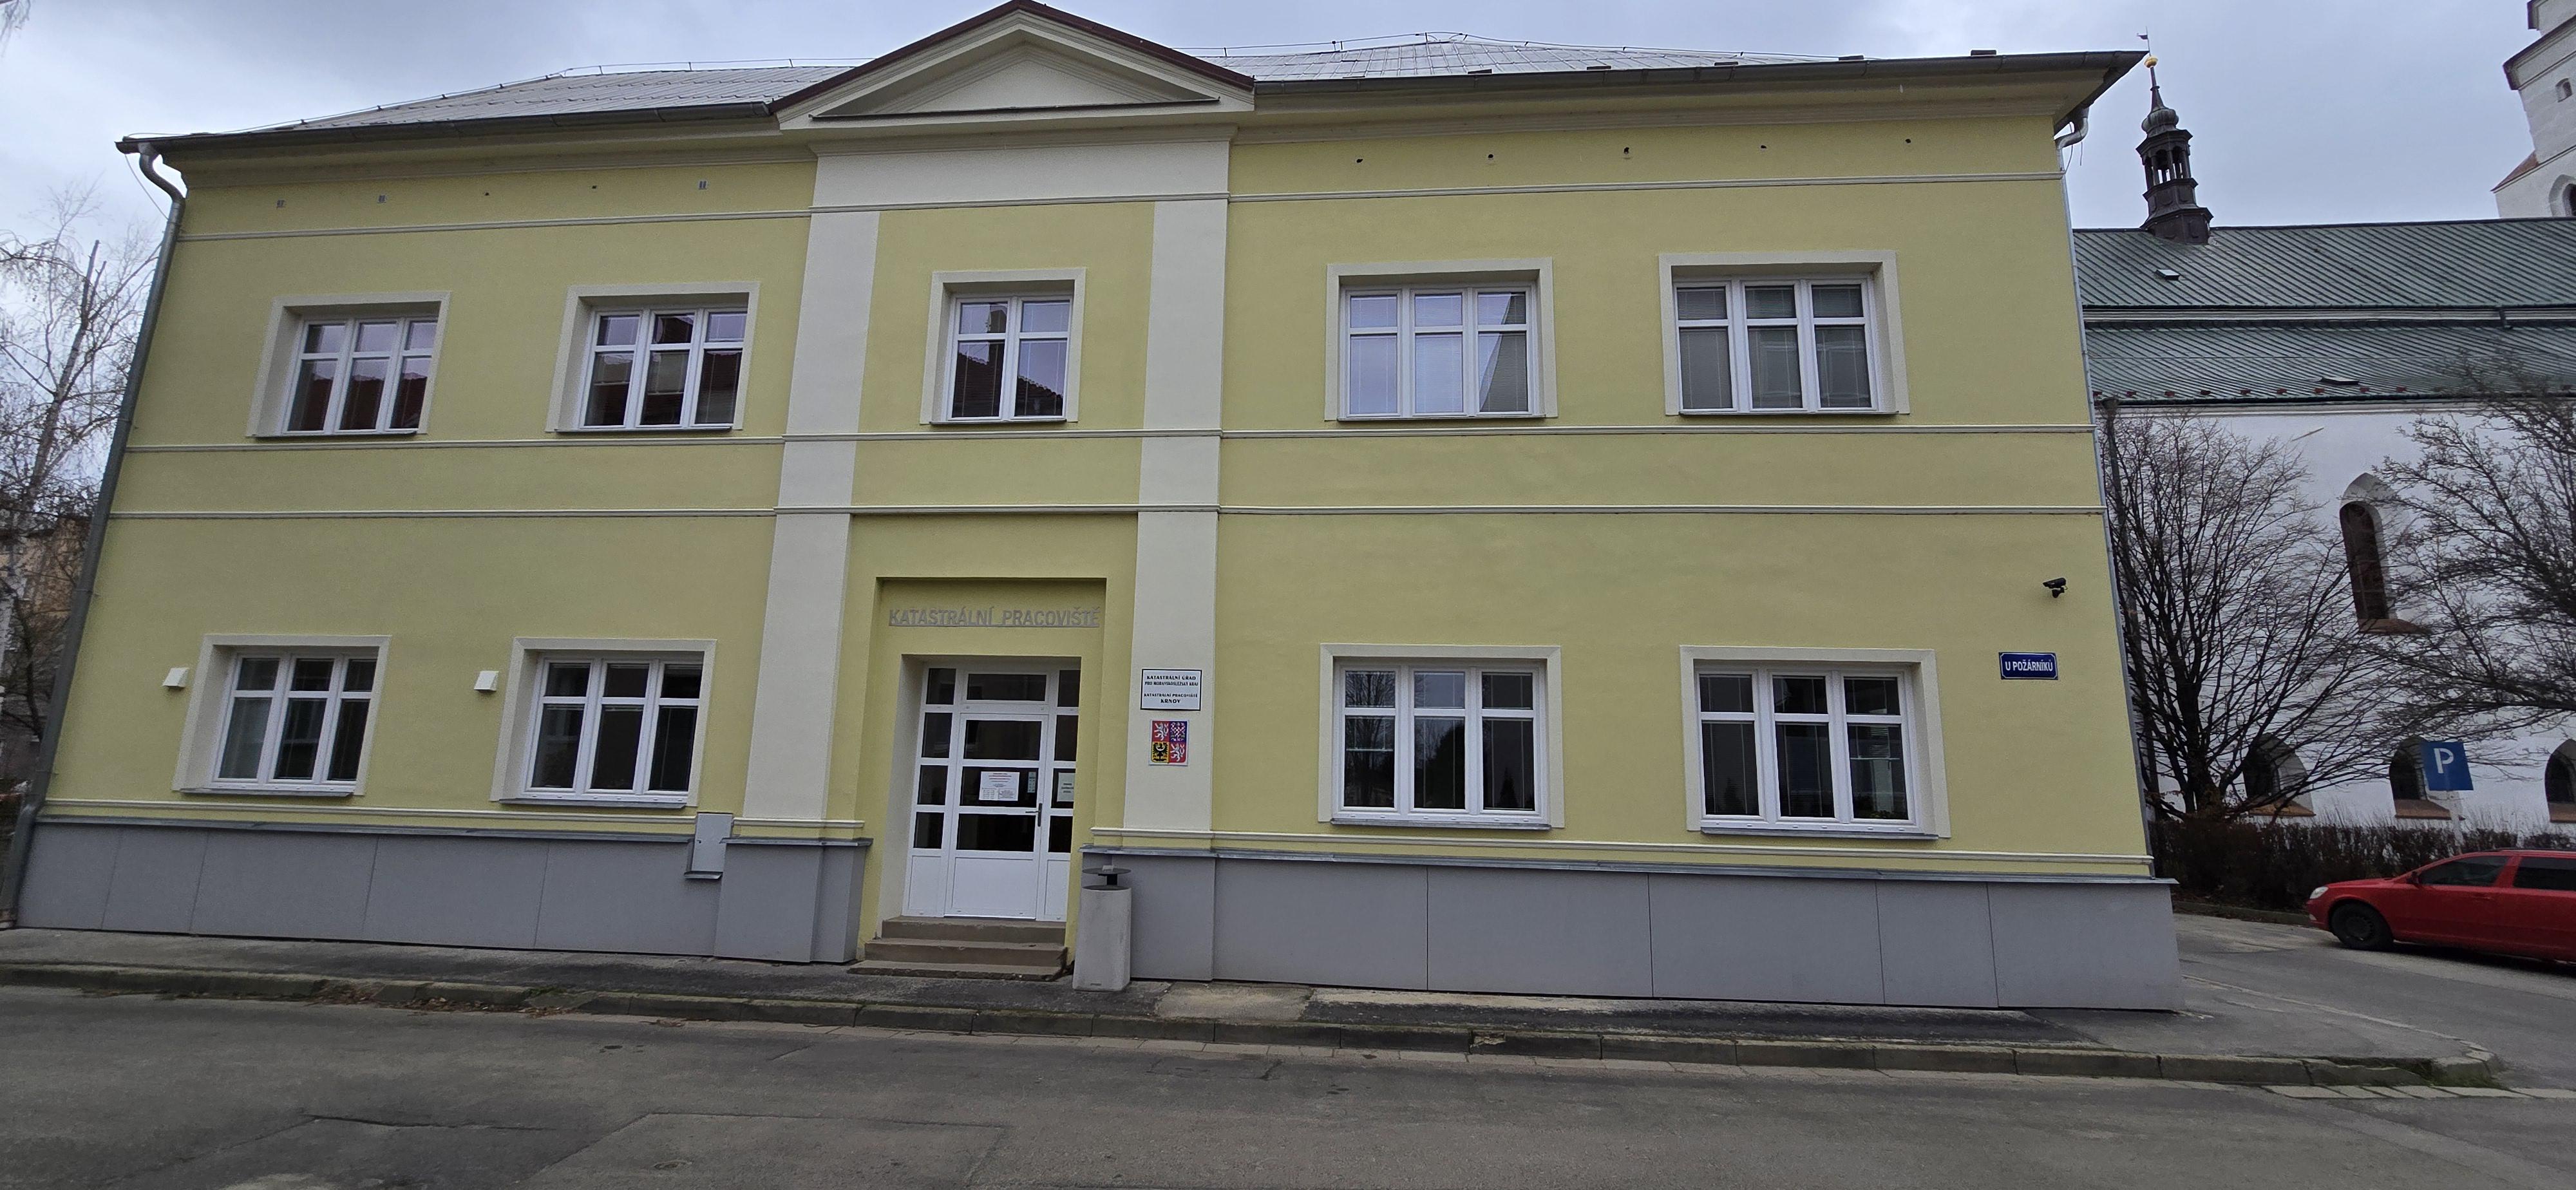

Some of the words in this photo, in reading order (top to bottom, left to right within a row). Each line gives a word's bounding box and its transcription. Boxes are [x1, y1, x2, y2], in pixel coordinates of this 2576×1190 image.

[889, 606, 995, 625] KATASTRÁLNÍ
[1002, 606, 1100, 625] PRACOVIŠTĚ
[2005, 661, 2011, 671] U
[2012, 659, 2053, 672] POŽÁRNÍKŮ
[2434, 748, 2454, 774] P
